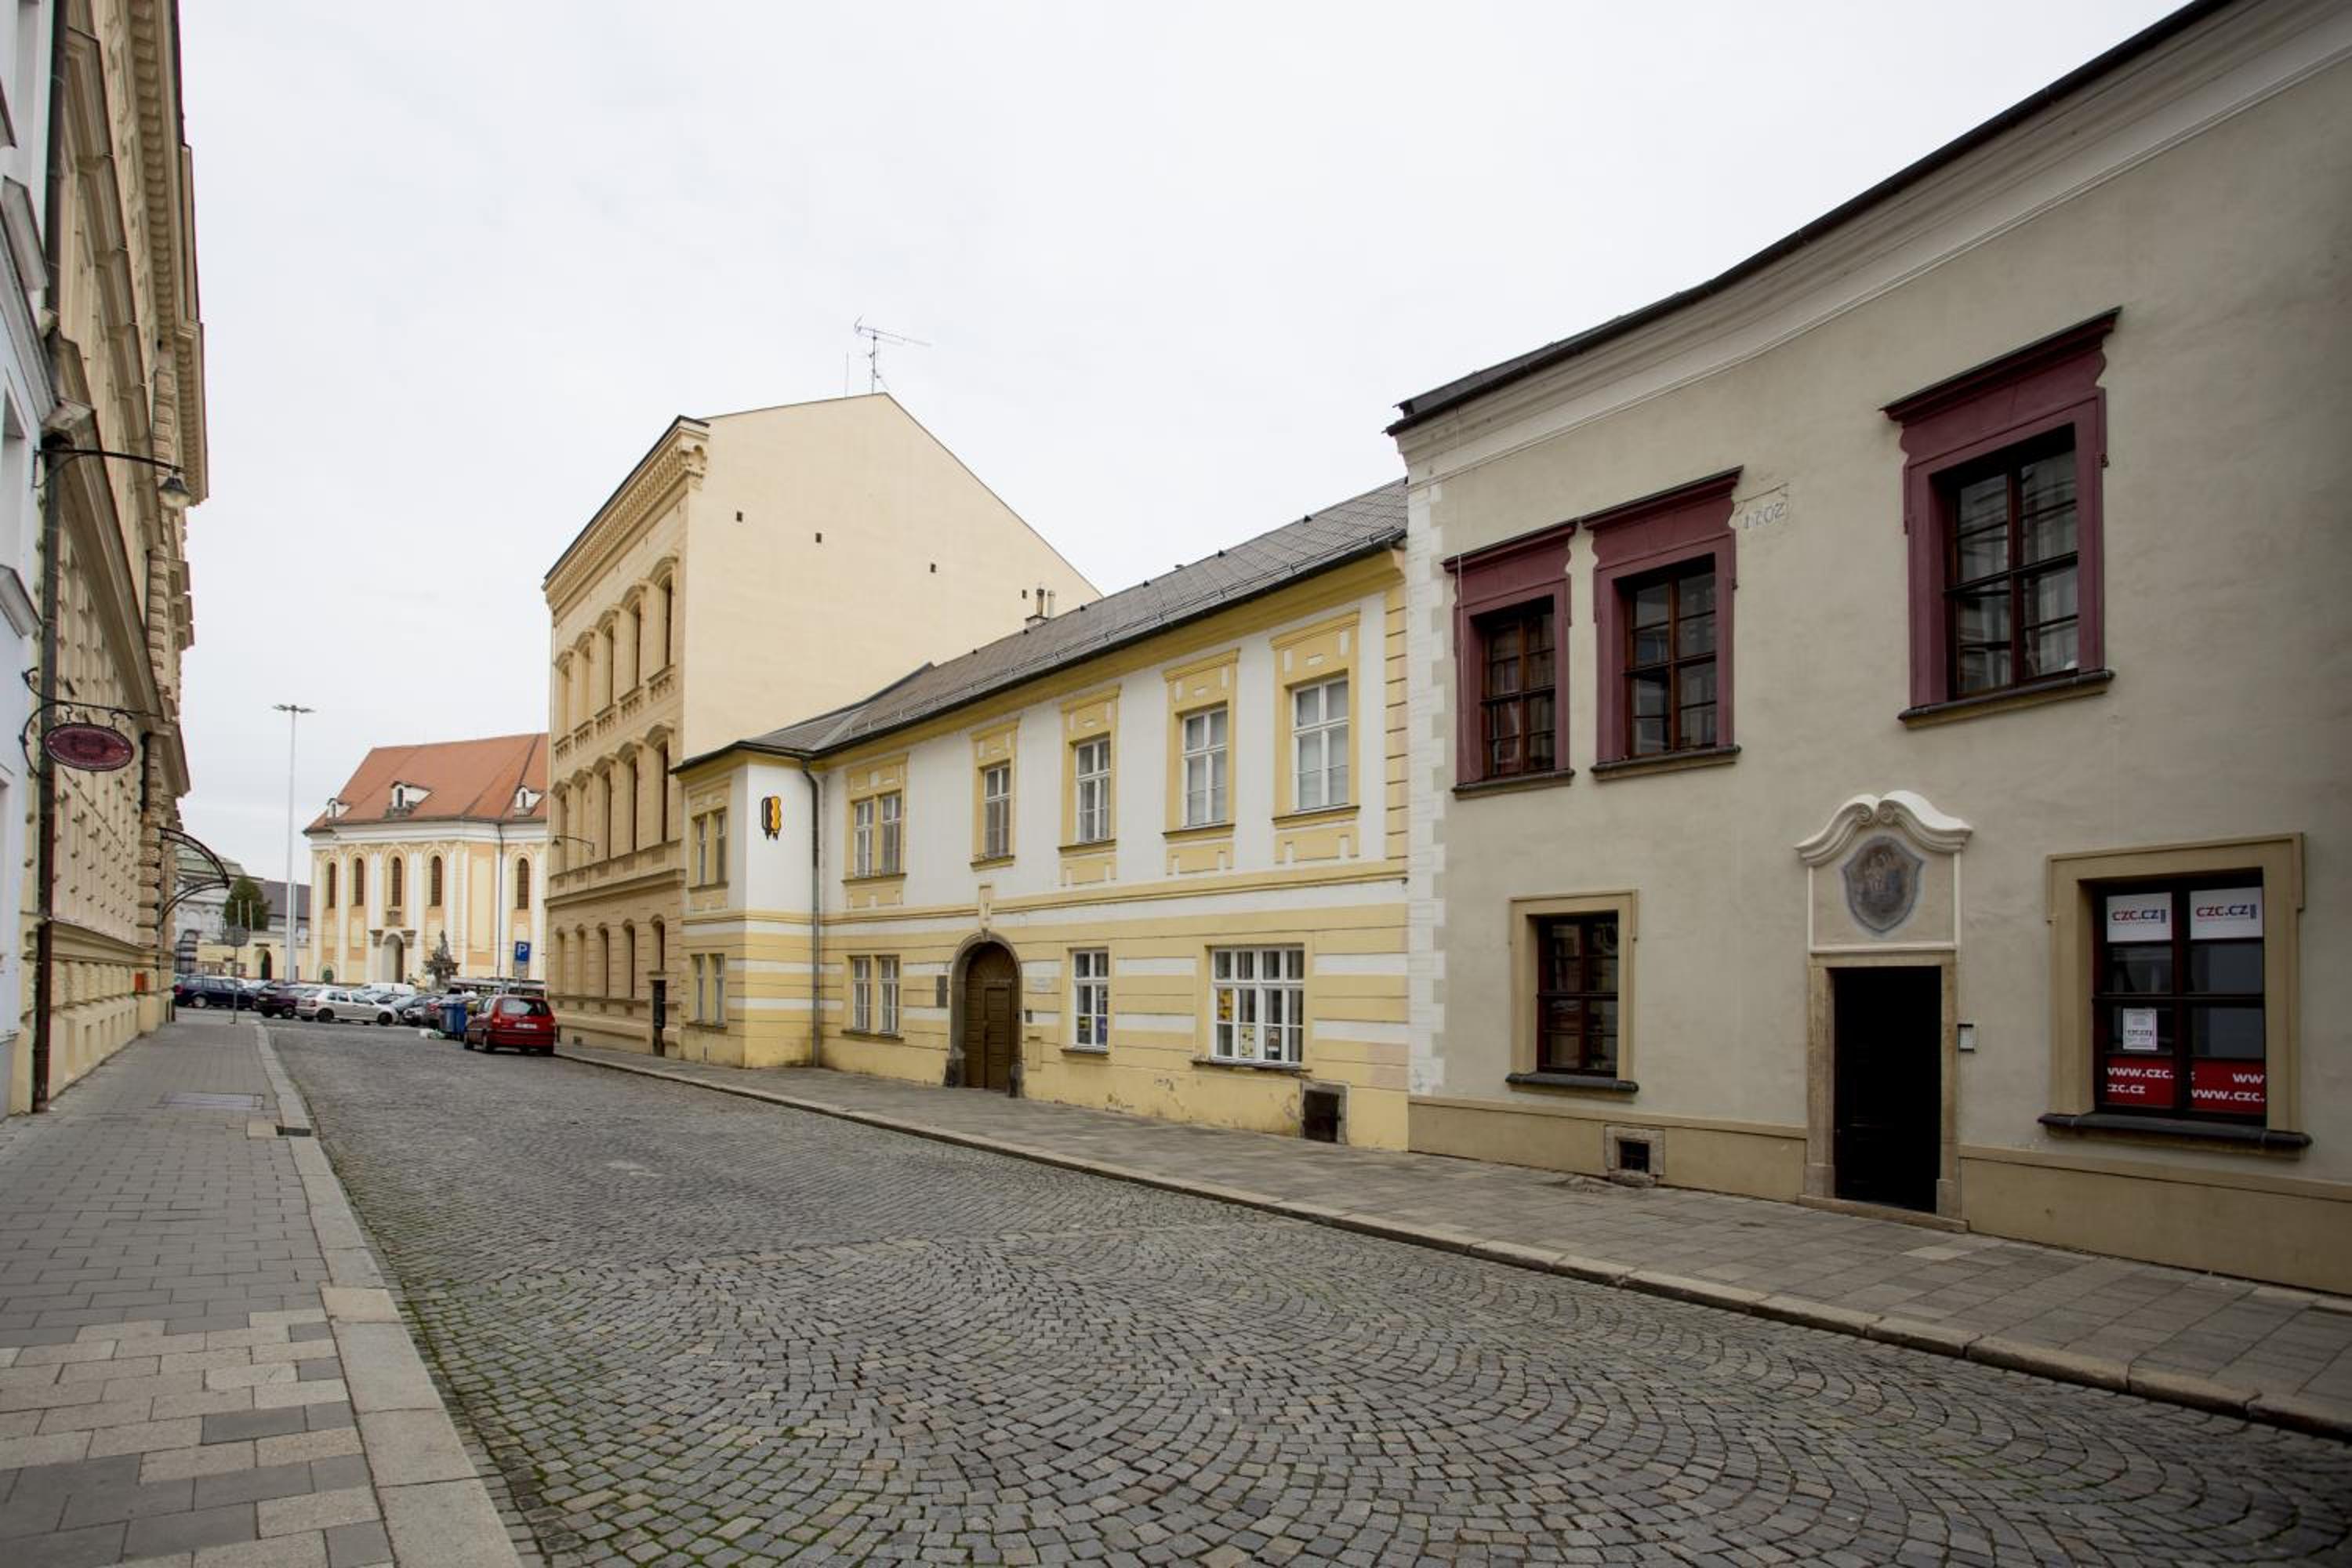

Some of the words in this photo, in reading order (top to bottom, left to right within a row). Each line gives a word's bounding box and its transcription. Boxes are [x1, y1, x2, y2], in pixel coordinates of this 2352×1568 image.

[2112, 909, 2158, 921] czc.cz
[2196, 904, 2249, 917] czc.cz
[517, 943, 528, 956] P
